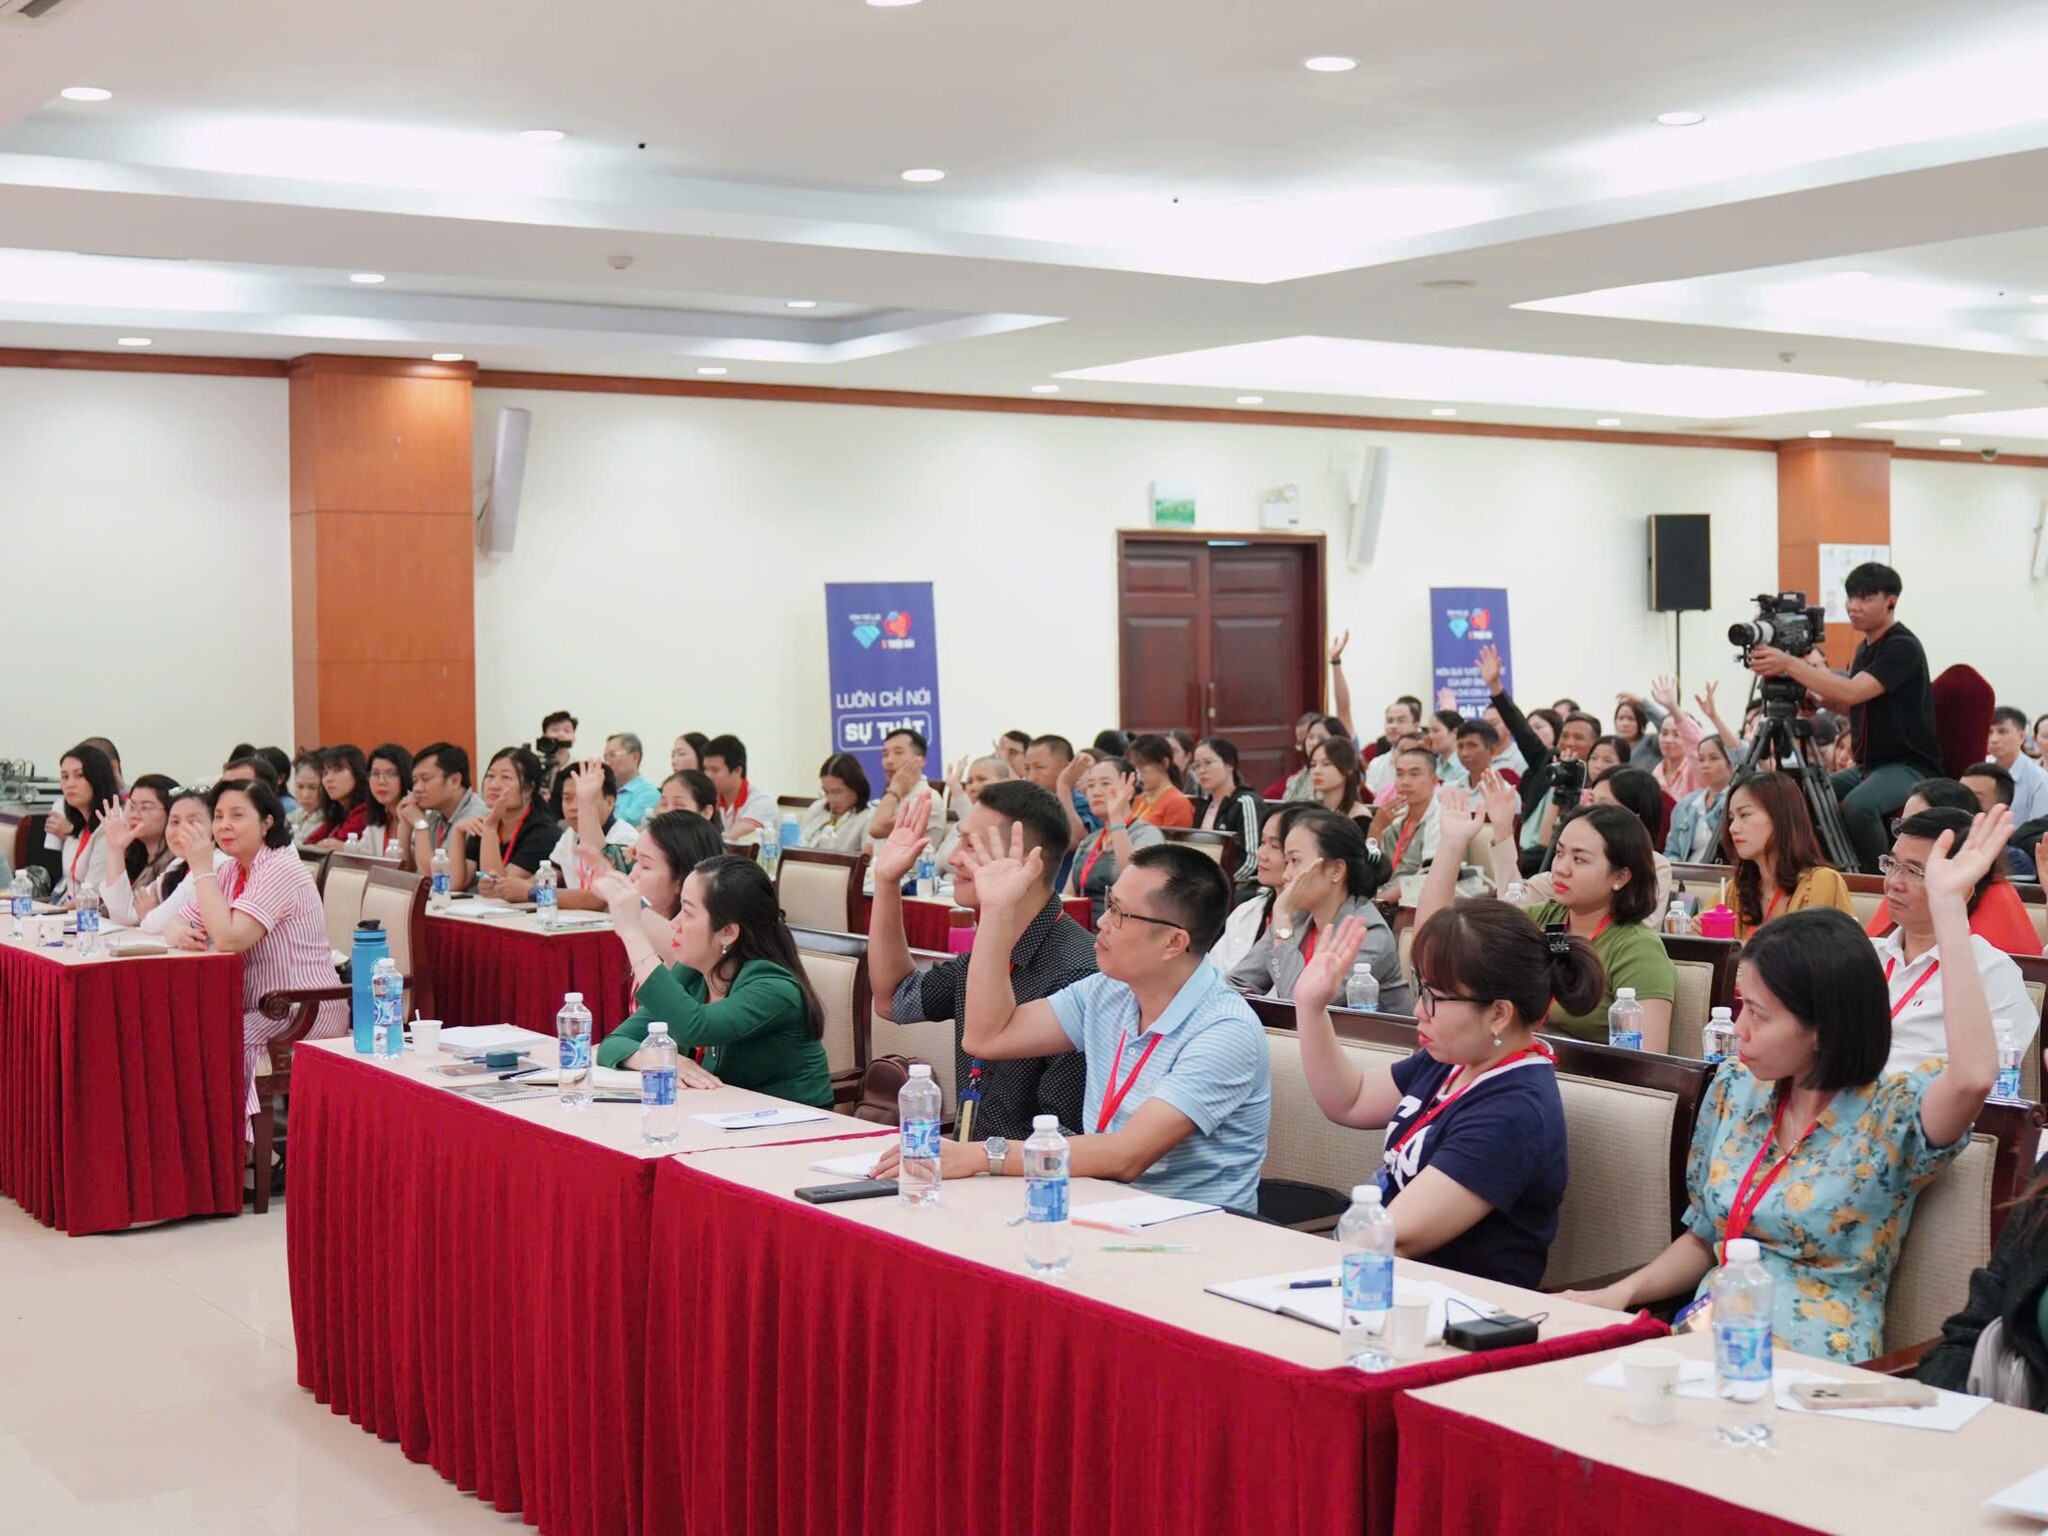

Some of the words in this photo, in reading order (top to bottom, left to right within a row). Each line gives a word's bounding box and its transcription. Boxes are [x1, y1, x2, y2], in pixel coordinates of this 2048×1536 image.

[836, 689, 876, 709] LUÔN
[880, 686, 904, 707] CHỈ
[906, 686, 931, 706] NÓI
[844, 720, 873, 745] SỰ
